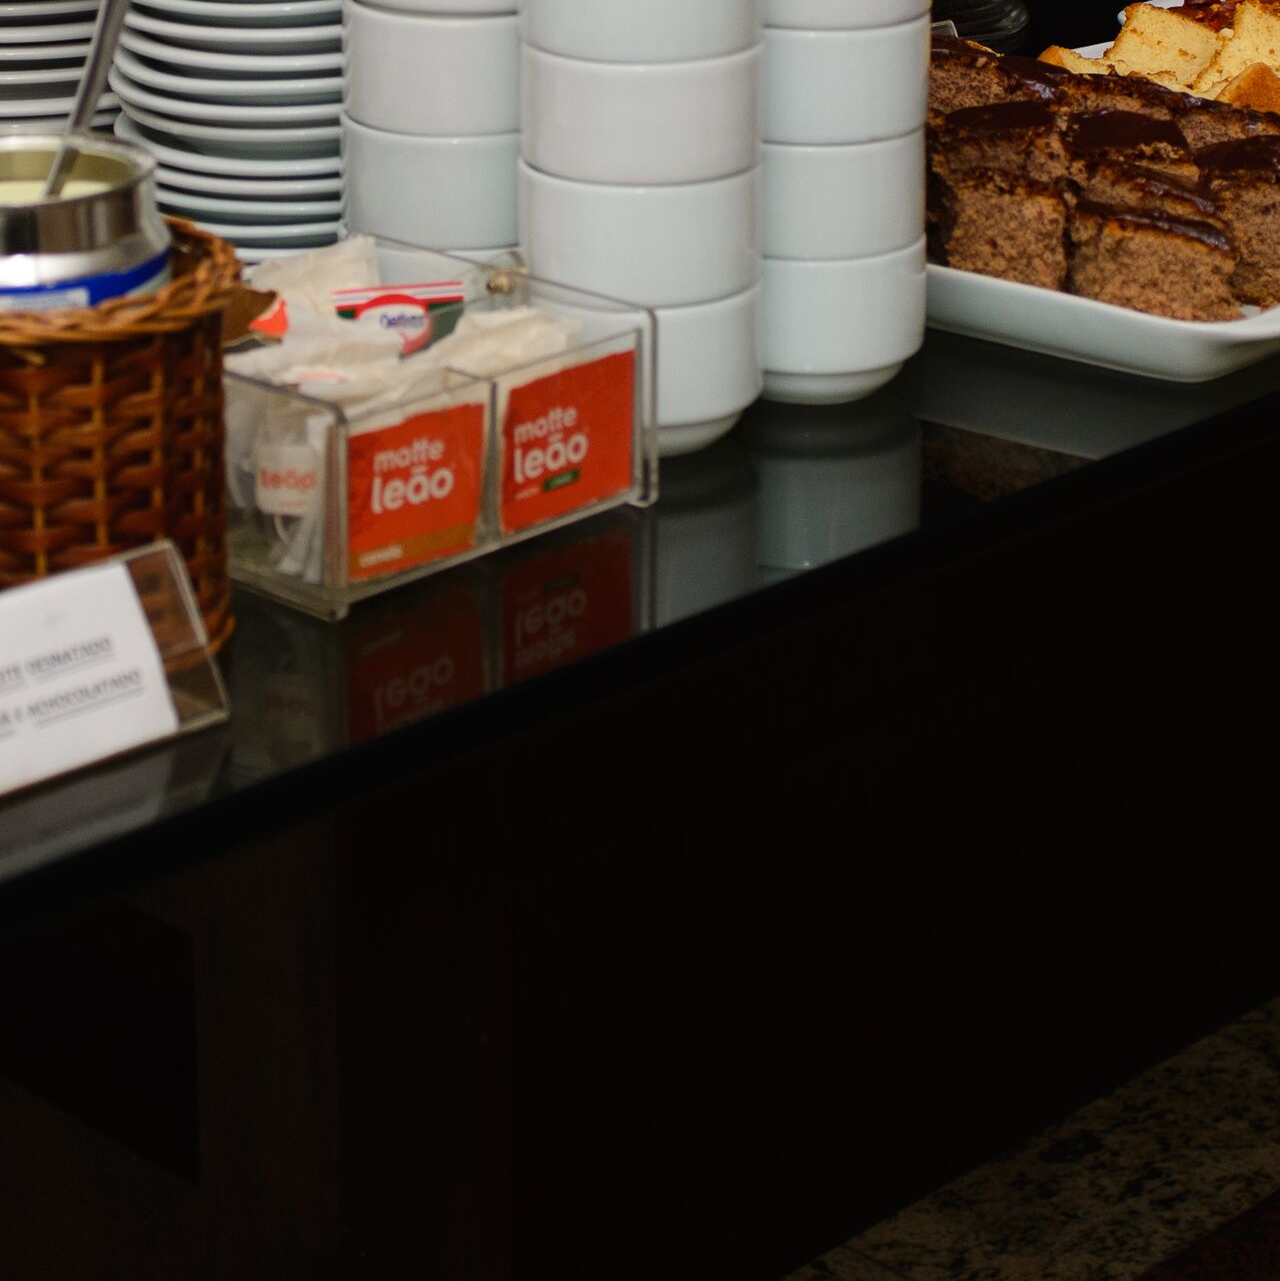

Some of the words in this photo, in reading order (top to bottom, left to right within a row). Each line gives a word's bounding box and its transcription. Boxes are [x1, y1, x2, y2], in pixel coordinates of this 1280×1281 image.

[513, 406, 578, 447] matte
[373, 437, 445, 474] matte
[513, 431, 589, 484] leão
[371, 464, 455, 514] leão
